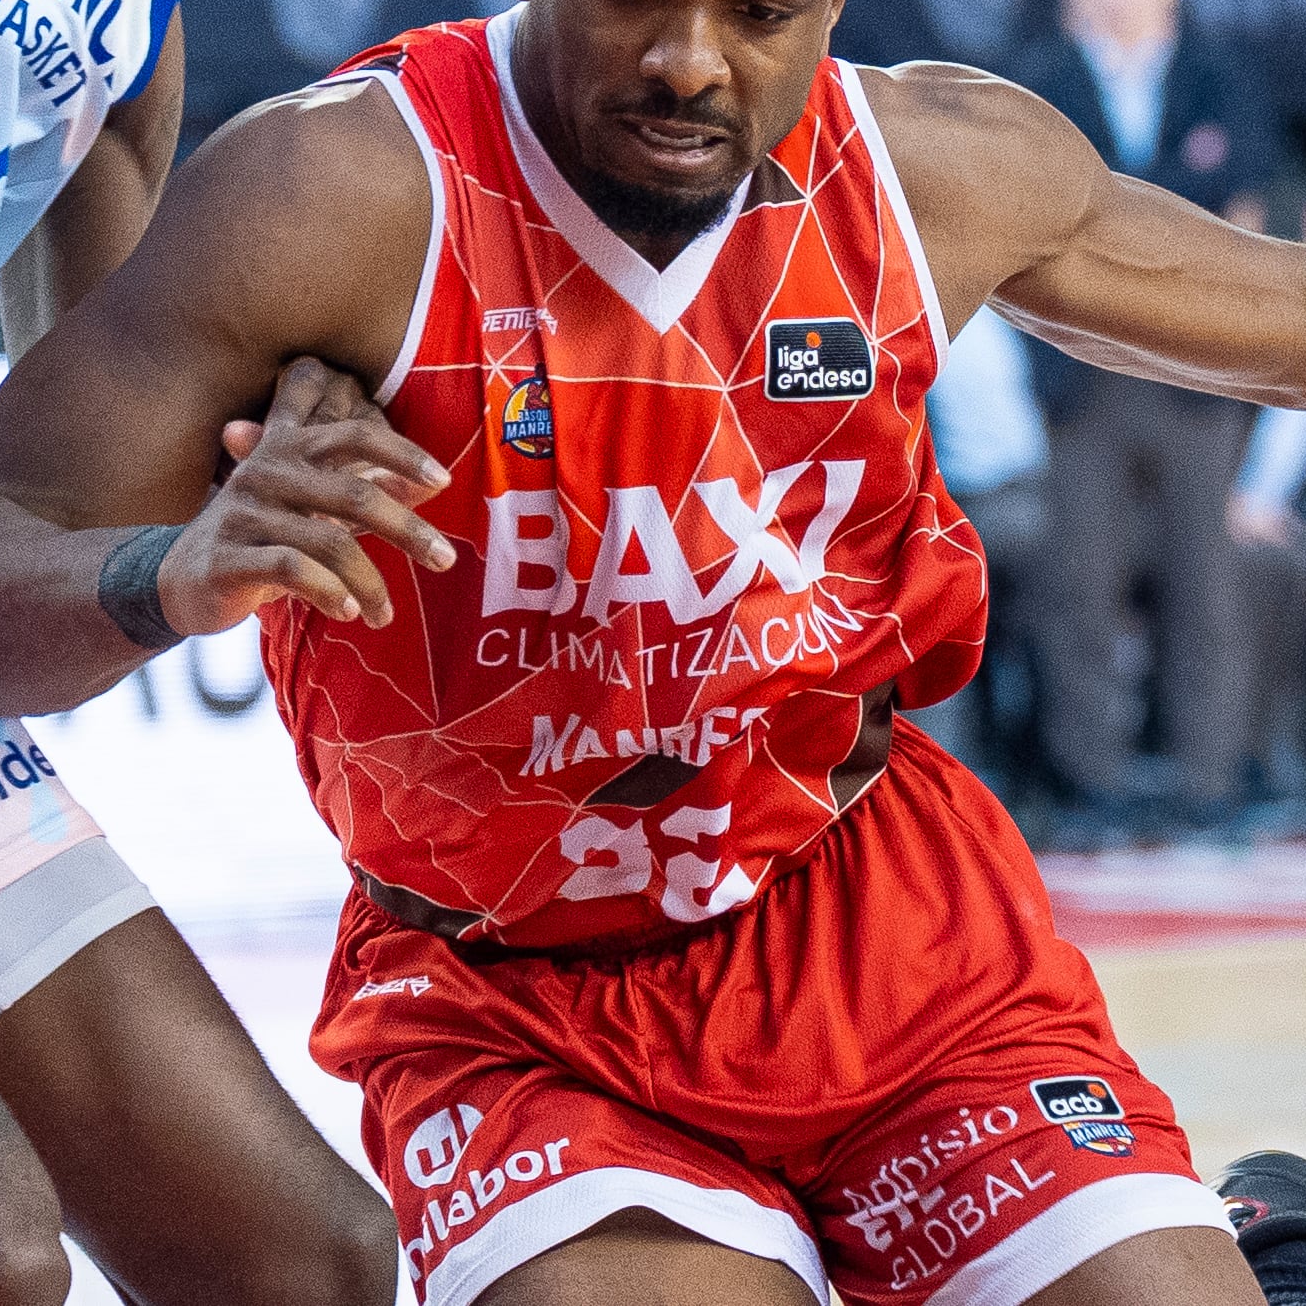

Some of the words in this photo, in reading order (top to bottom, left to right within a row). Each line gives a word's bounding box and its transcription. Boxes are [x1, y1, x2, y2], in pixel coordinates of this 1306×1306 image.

[777, 347, 819, 371] liga
[777, 366, 867, 390] endesa
[481, 459, 866, 627] BAXI
[1049, 1092, 1104, 1116] acb
